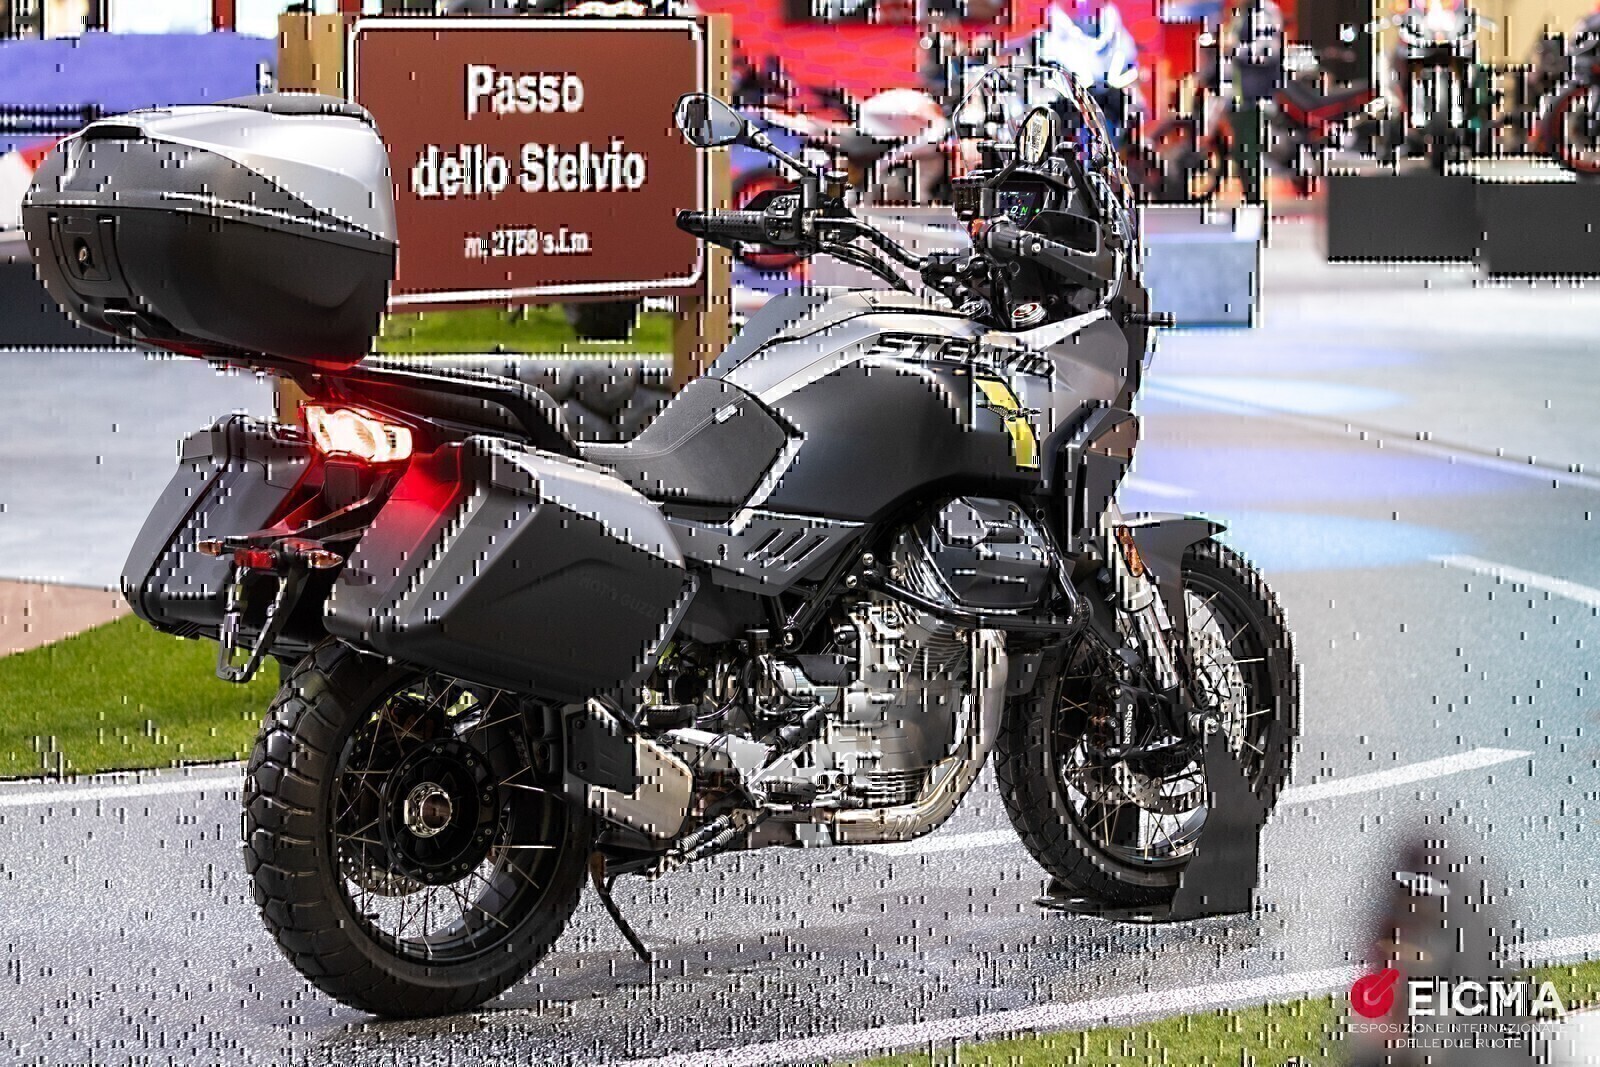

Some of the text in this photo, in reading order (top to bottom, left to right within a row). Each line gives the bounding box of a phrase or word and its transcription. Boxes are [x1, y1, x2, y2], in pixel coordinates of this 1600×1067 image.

[466, 64, 584, 115] Passo
[413, 138, 646, 198] dello Stelvio
[491, 228, 538, 257] 2758
[620, 593, 660, 619] GUZZI
[1122, 703, 1134, 745] brembo
